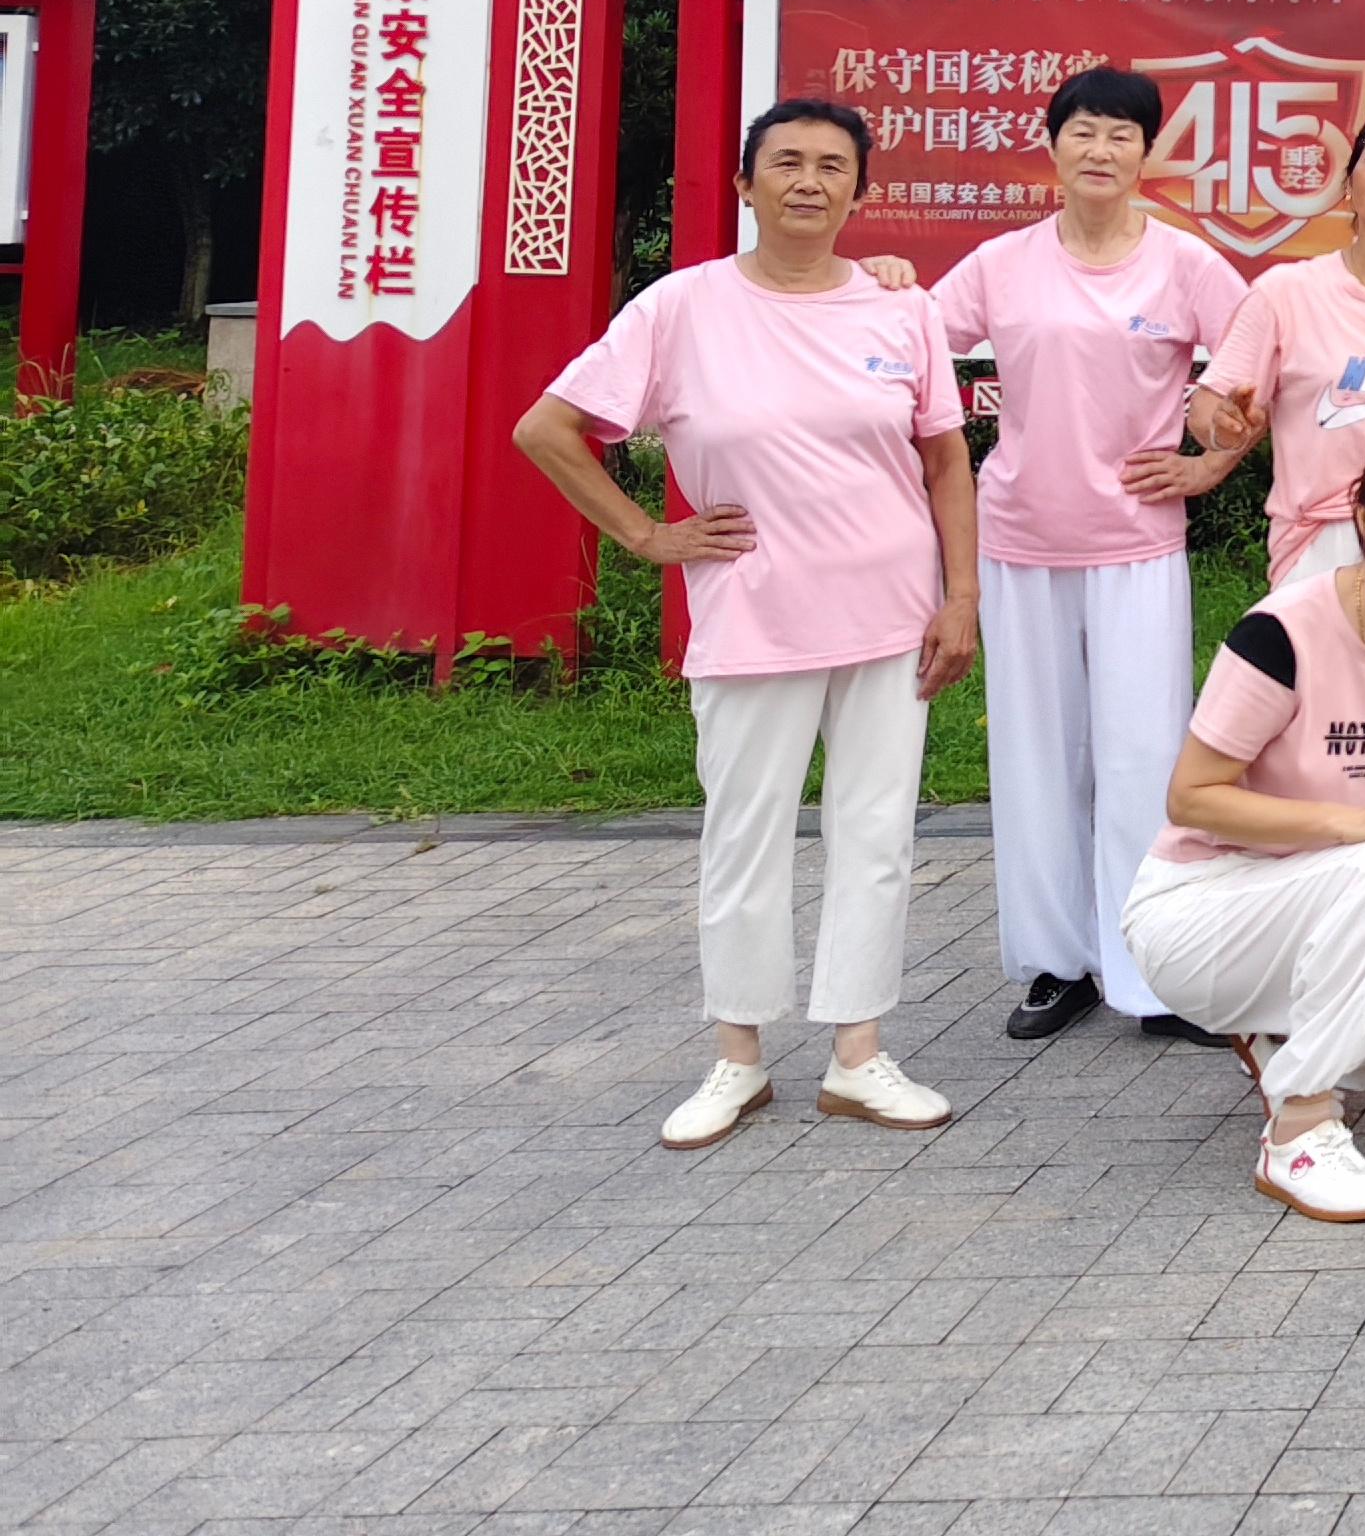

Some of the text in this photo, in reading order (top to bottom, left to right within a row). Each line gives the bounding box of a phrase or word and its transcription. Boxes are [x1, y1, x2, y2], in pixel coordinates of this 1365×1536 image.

[348, 24, 370, 92] QUAN
[345, 96, 367, 164] XUAN
[1280, 167, 1325, 190] 安全
[1281, 145, 1325, 167] 国家
[340, 167, 362, 249] CHUAN
[864, 209, 921, 220] NATIONAL
[924, 209, 976, 220] SECURITY
[977, 209, 1042, 221] EDUCATION
[337, 254, 358, 301] LAN
